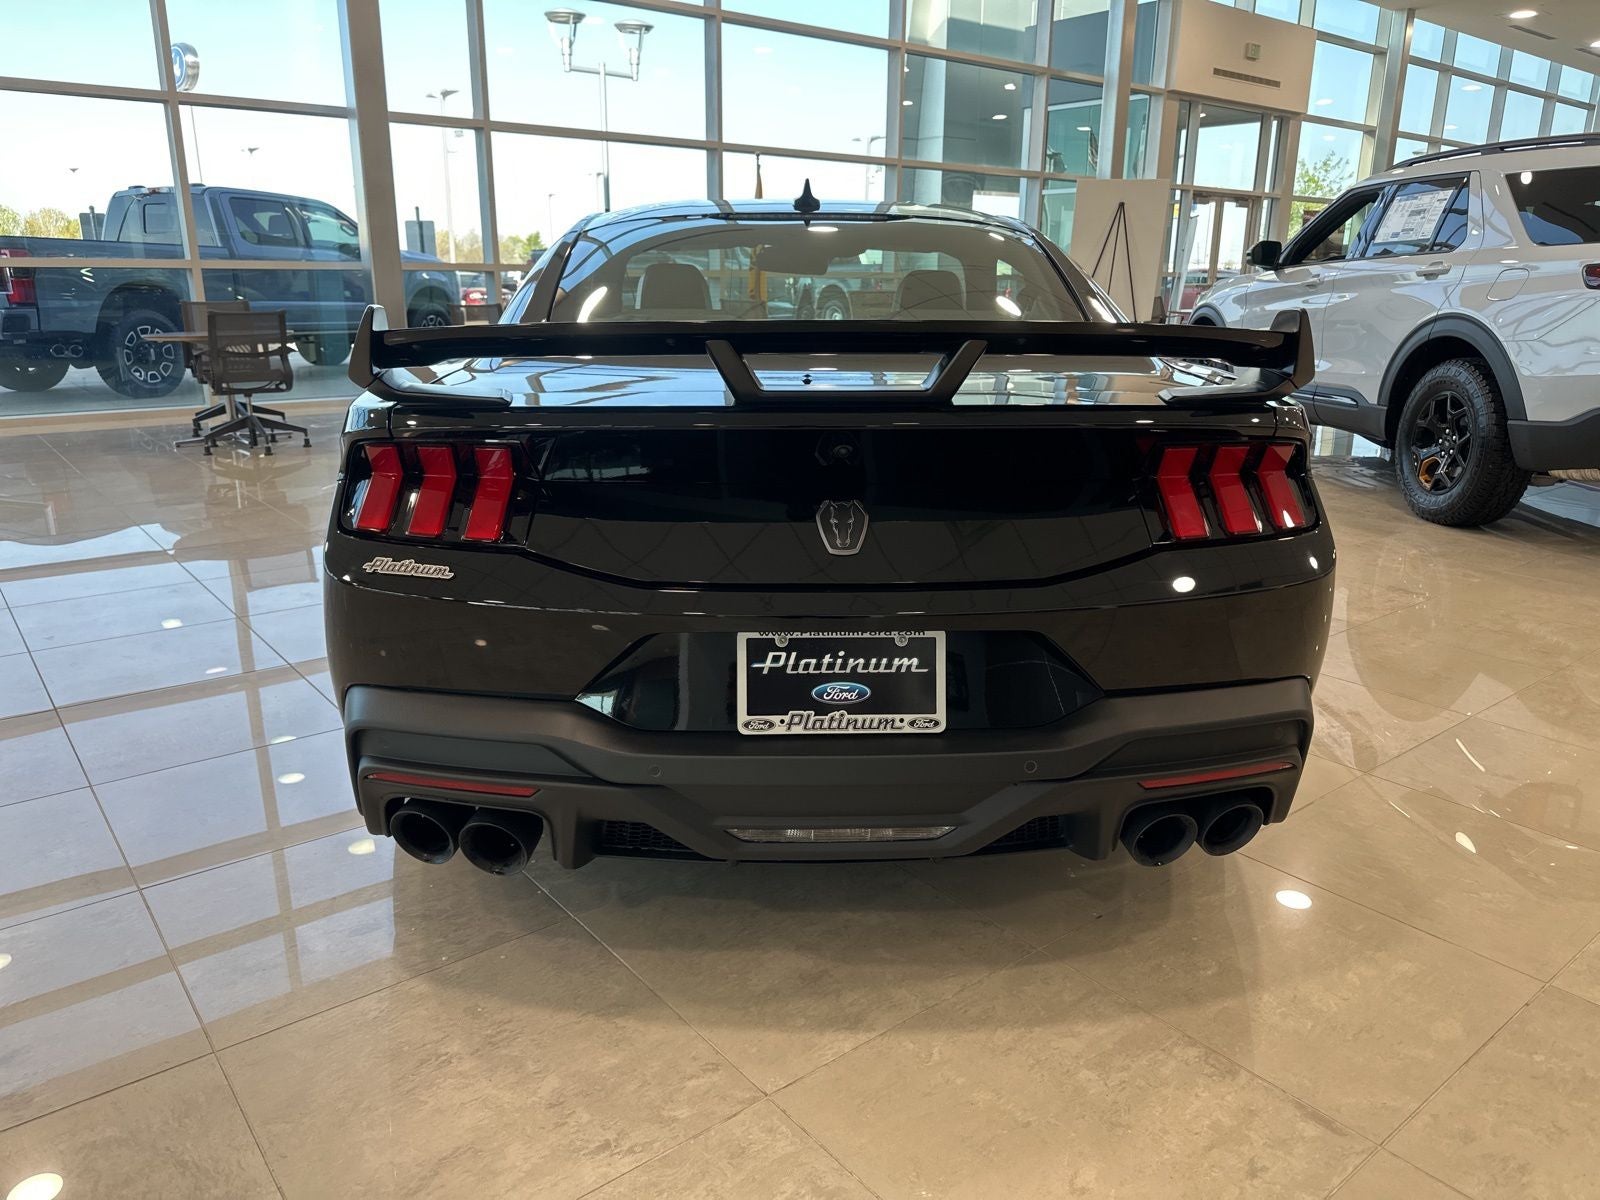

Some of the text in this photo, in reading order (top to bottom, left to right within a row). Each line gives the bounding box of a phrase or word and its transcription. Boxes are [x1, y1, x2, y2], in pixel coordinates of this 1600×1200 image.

[362, 556, 455, 580] Platinum
[749, 650, 929, 675] Platinum
[822, 684, 860, 701] Ford
[747, 711, 936, 733] Ford Platinum Ford
